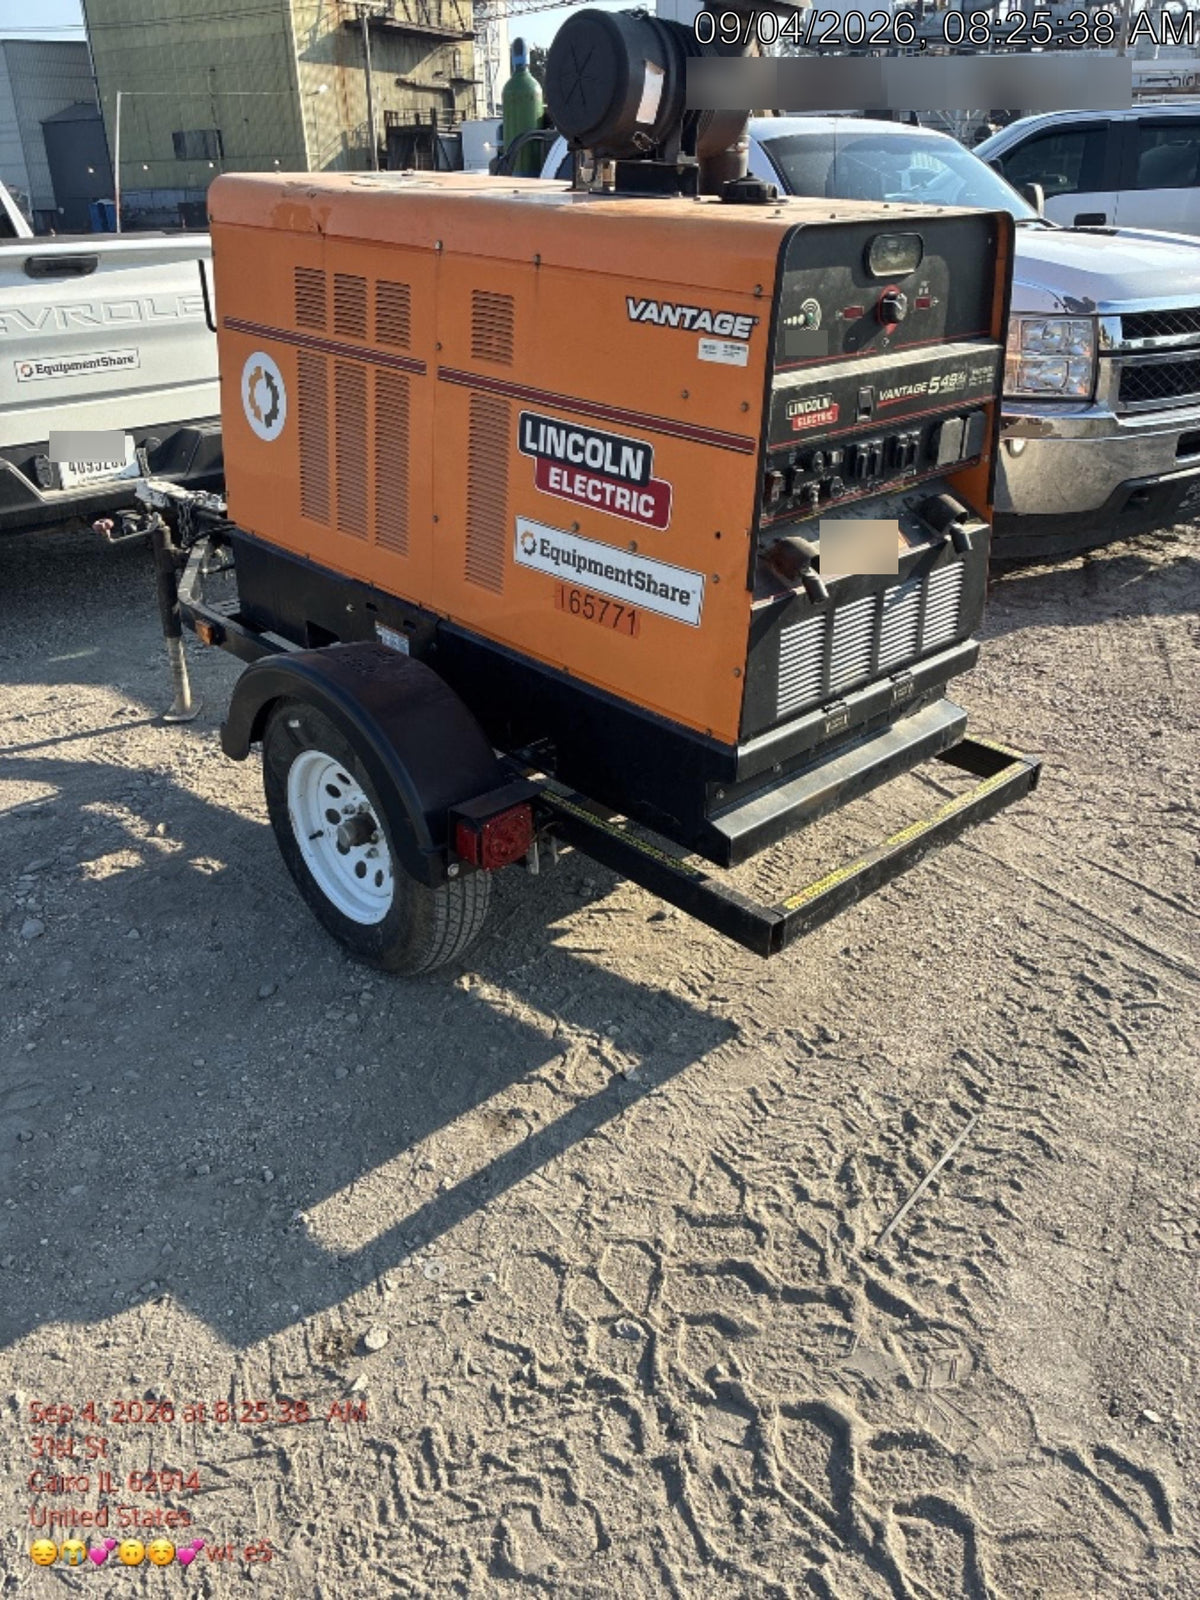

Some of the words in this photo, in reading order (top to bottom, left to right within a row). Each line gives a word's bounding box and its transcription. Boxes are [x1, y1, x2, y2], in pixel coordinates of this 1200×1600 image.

[626, 296, 753, 341] VANTAGE
[35, 356, 135, 376] EquipmentShare
[788, 397, 830, 417] LINCOLN
[879, 381, 929, 401] VANTAGE
[797, 410, 834, 428] ELECTRIC
[524, 420, 644, 481] LINCOLN
[549, 466, 656, 518] ELECTRIC
[539, 537, 692, 606] EquipmentShare
[560, 585, 637, 636] 165771
